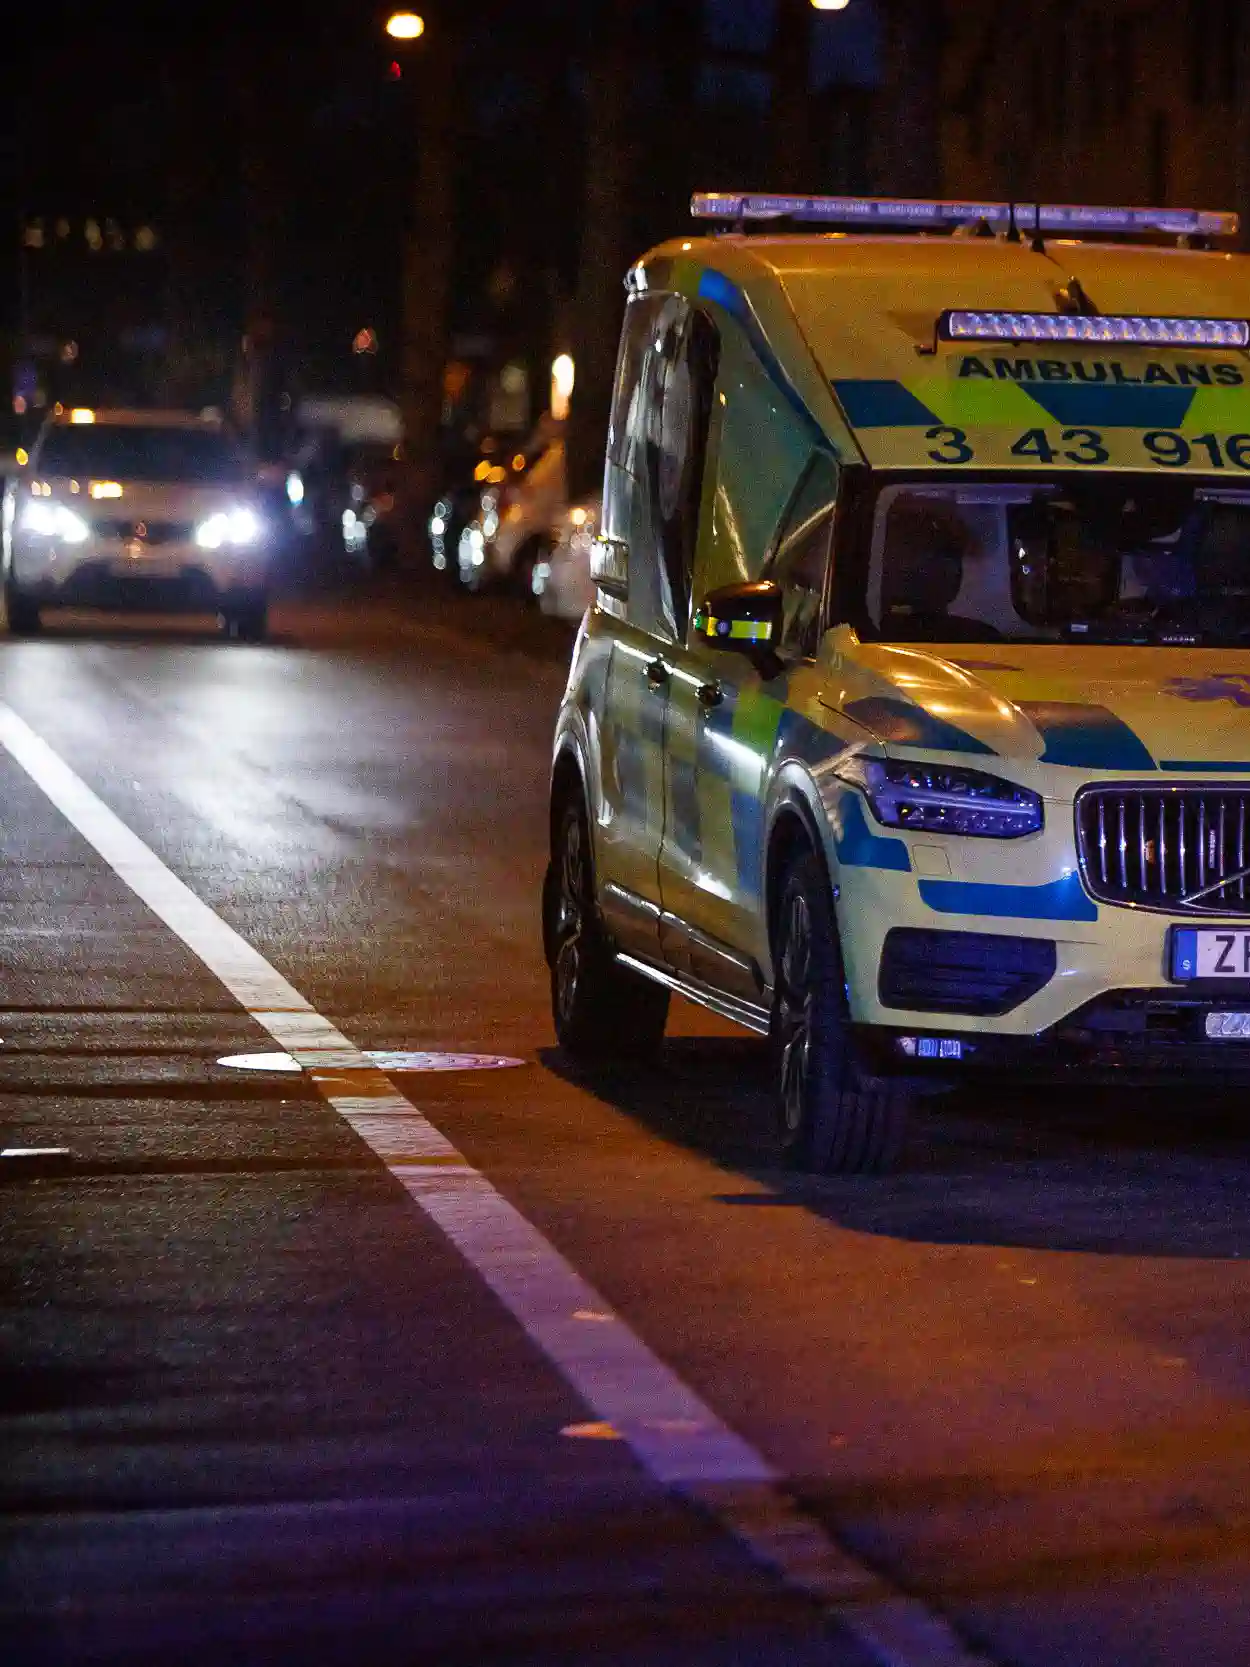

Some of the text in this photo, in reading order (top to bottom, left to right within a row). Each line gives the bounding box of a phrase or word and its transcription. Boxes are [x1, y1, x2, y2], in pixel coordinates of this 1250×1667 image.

[957, 356, 1244, 386] AMBULANS
[925, 428, 974, 464] 3
[1010, 429, 1110, 464] 43
[1182, 960, 1192, 970] S
